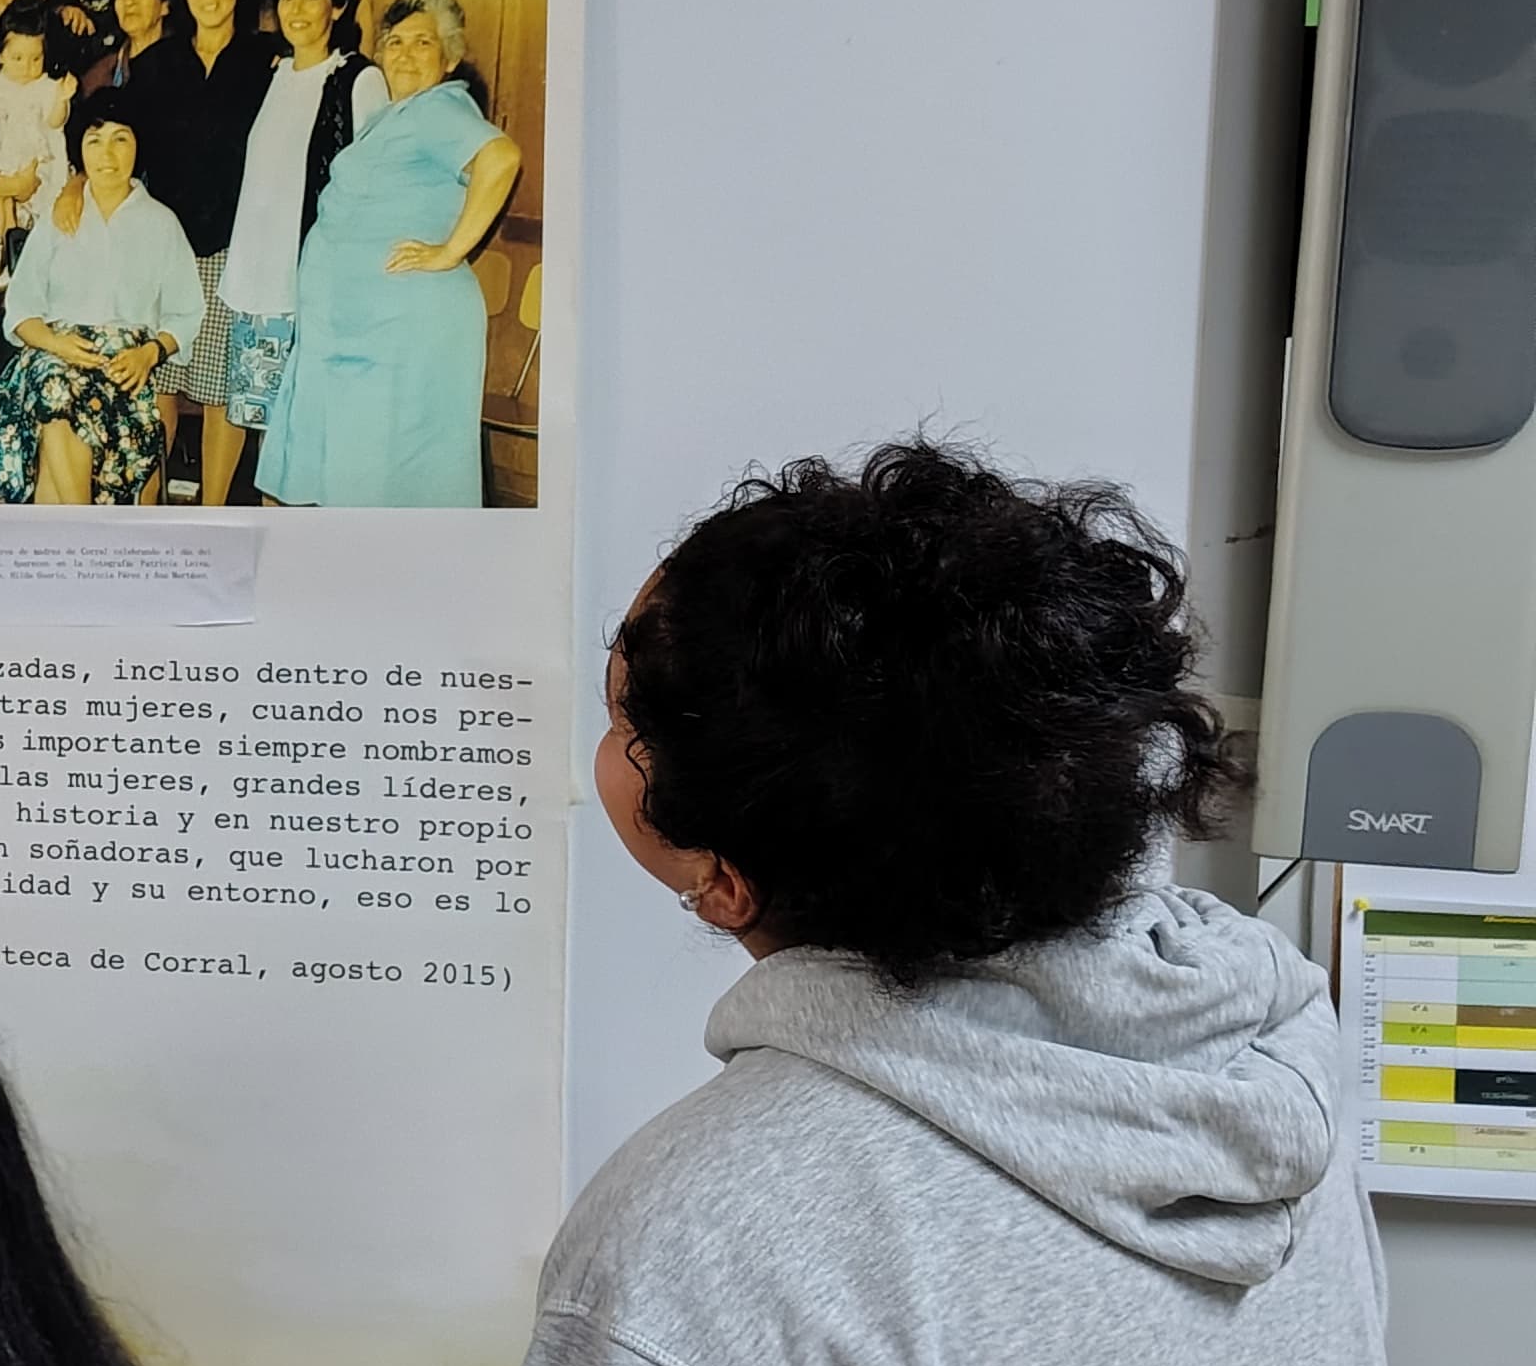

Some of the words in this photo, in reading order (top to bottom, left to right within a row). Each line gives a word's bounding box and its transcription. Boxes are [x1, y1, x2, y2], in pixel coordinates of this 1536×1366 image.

[113, 658, 240, 683] incluso
[256, 661, 369, 687] dentro
[385, 664, 423, 688] de
[439, 671, 534, 695] nues-
[84, 694, 228, 724] mujeres,
[252, 699, 363, 723] cuando
[383, 706, 438, 725] nos
[457, 709, 534, 732] pre-
[22, 727, 200, 758] importante
[217, 733, 347, 764] siempre
[362, 739, 532, 767] nombramos
[0, 762, 49, 788] las
[66, 766, 209, 797] mujeres,
[232, 773, 361, 799] grandes
[381, 775, 528, 808] líderes,
[15, 800, 160, 828] historia
[176, 811, 197, 835] y
[213, 812, 251, 830] en
[268, 812, 400, 835] nuestro
[417, 815, 533, 844] propio
[1347, 809, 1433, 834] SMART
[29, 838, 204, 870] soñadoras,
[228, 849, 284, 873] que
[305, 846, 455, 874] lucharon
[474, 858, 533, 882] por
[91, 881, 111, 904] y
[131, 882, 166, 900] su
[187, 881, 330, 911] entorno,
[356, 890, 413, 909] eso
[434, 893, 471, 912] es
[495, 890, 532, 915] lo
[89, 947, 125, 971] de
[143, 951, 267, 981] Corral,
[291, 960, 403, 985] agosto
[423, 961, 512, 993] 2015)
